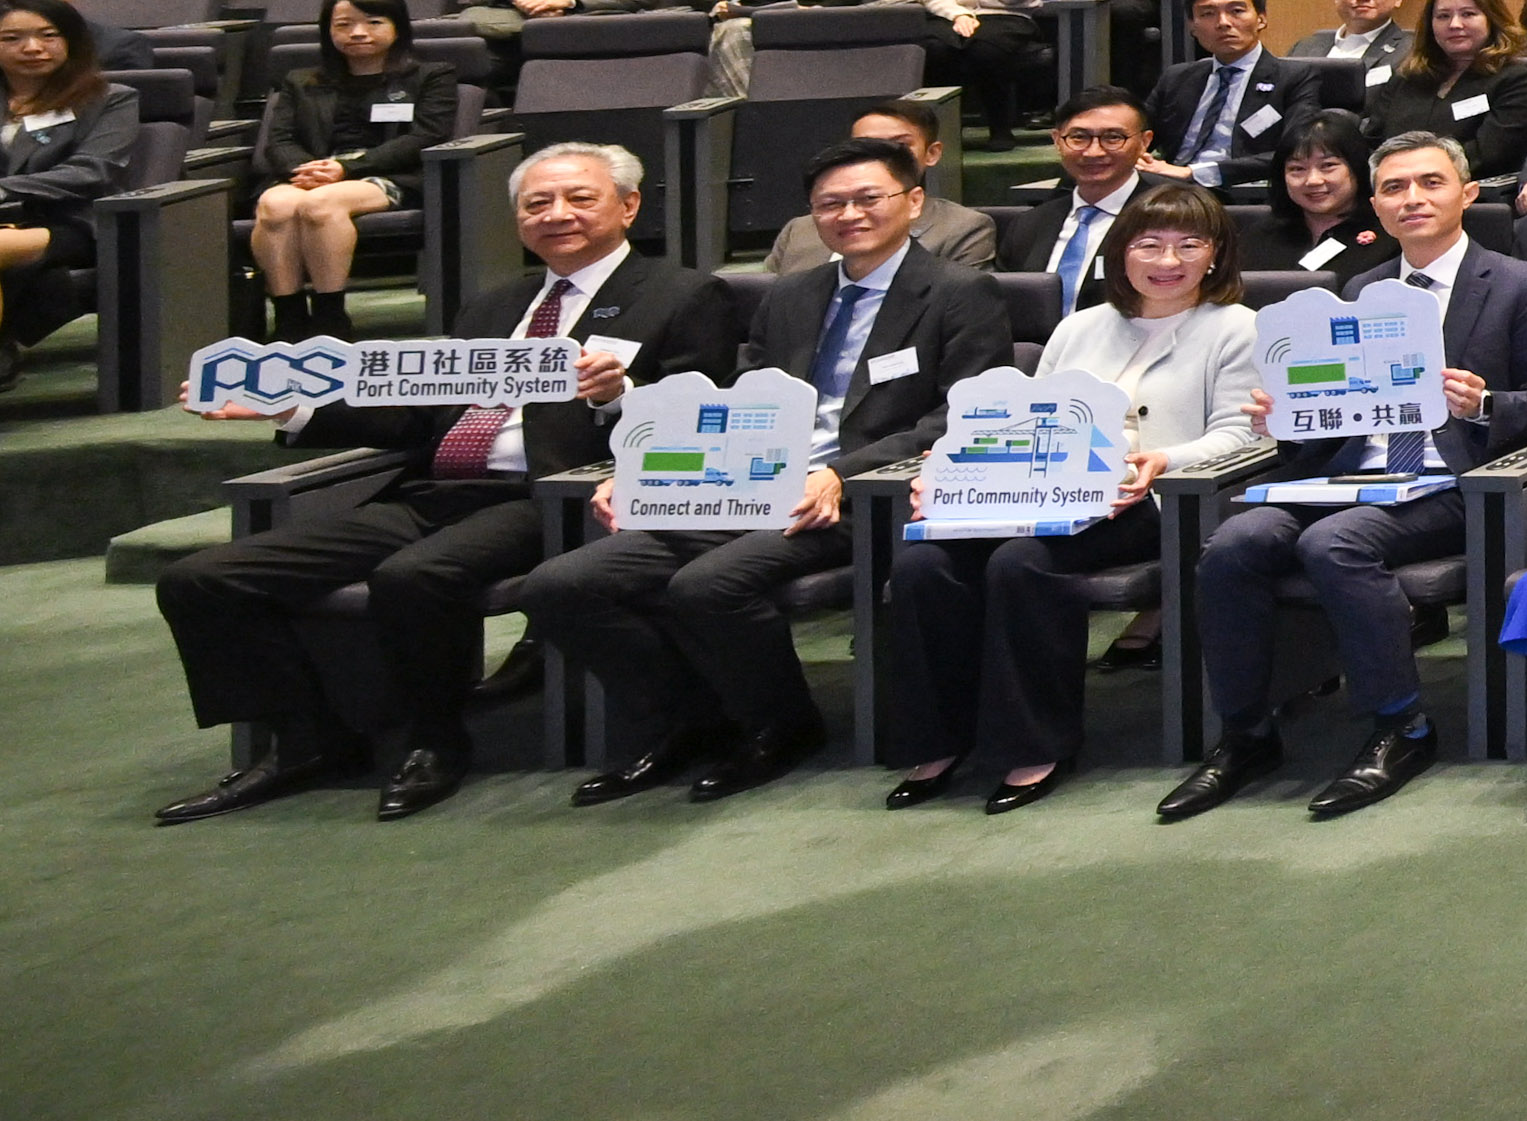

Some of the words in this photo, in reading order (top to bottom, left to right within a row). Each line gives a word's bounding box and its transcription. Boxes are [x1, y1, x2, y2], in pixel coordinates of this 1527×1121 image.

[358, 346, 570, 377] 港口社區系統
[199, 351, 347, 402] PCS
[356, 380, 395, 398] Port
[398, 378, 499, 399] Community
[503, 376, 567, 398] System
[630, 498, 691, 516] Connect
[694, 499, 722, 516] and
[727, 498, 771, 516] Thrive
[933, 488, 963, 505] Port
[967, 487, 1048, 507] Community
[1051, 486, 1104, 507] System
